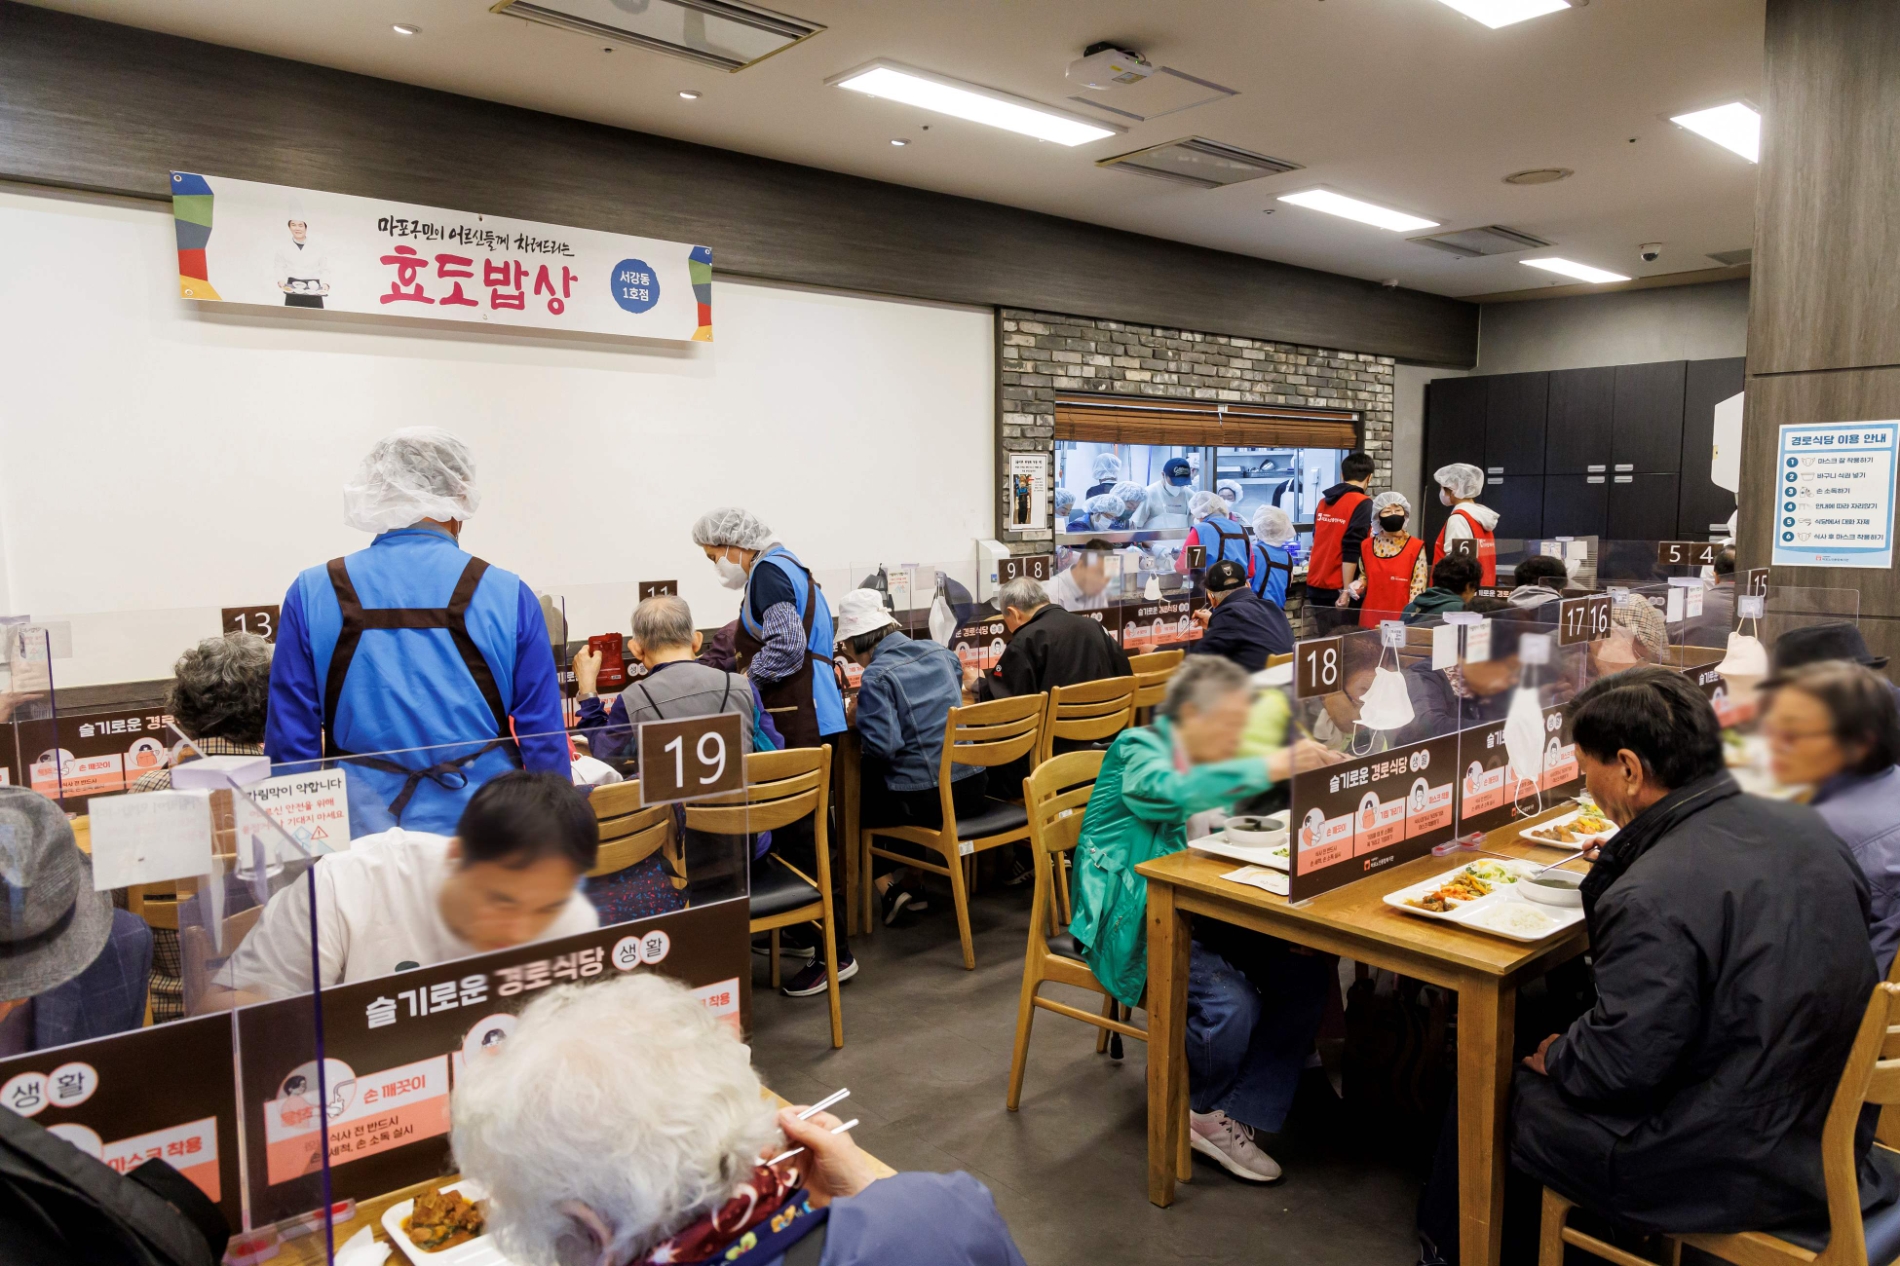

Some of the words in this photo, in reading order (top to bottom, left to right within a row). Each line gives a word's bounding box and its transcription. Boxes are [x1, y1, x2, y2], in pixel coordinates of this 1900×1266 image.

[377, 215, 445, 241] 마포구민이
[449, 225, 509, 252] 어르신들께
[514, 233, 575, 257] 차려드리는
[379, 245, 579, 316] 효도밥상
[620, 271, 650, 286] 서강동
[623, 287, 649, 301] 1호점
[1791, 434, 1834, 446] 경로식당
[1837, 434, 1860, 444] 이용
[1864, 433, 1886, 443] 안내
[1847, 456, 1873, 464] 착용하기
[1193, 549, 1201, 566] 7
[1460, 541, 1470, 555] 6
[1669, 545, 1681, 563] 5
[1700, 546, 1714, 563] 4
[1007, 562, 1016, 580] 9
[1034, 561, 1042, 578] 8
[1754, 575, 1768, 598] 15
[234, 611, 273, 639] 13
[1566, 607, 1585, 637] 17
[1590, 604, 1608, 633] 16
[1306, 647, 1338, 688] 18
[79, 717, 142, 738] 슬기로운
[79, 763, 87, 772] 손
[88, 760, 111, 770] 깨끗이
[664, 731, 727, 788] 19
[1329, 766, 1369, 794] 슬기로운
[1371, 755, 1408, 782] 경로식당
[246, 785, 292, 801] 가림막이
[296, 777, 342, 795] 약합니다
[286, 800, 313, 814] 안전을
[317, 797, 335, 808] 위해
[287, 814, 314, 826] 기대지
[317, 810, 344, 822] 마세요
[366, 973, 488, 1029] 슬기로운
[494, 945, 605, 997] 경로식당
[619, 937, 664, 964] 생활
[12, 1070, 85, 1109] 생활
[363, 1088, 379, 1105] 손
[381, 1074, 426, 1099] 깨끗이
[329, 1128, 351, 1143] 식사
[354, 1125, 365, 1137] 전
[367, 1115, 399, 1133] 반드시
[355, 1138, 367, 1150] 손
[369, 1133, 391, 1147] 소독
[393, 1124, 414, 1140] 실시
[167, 1135, 203, 1157] 착용
